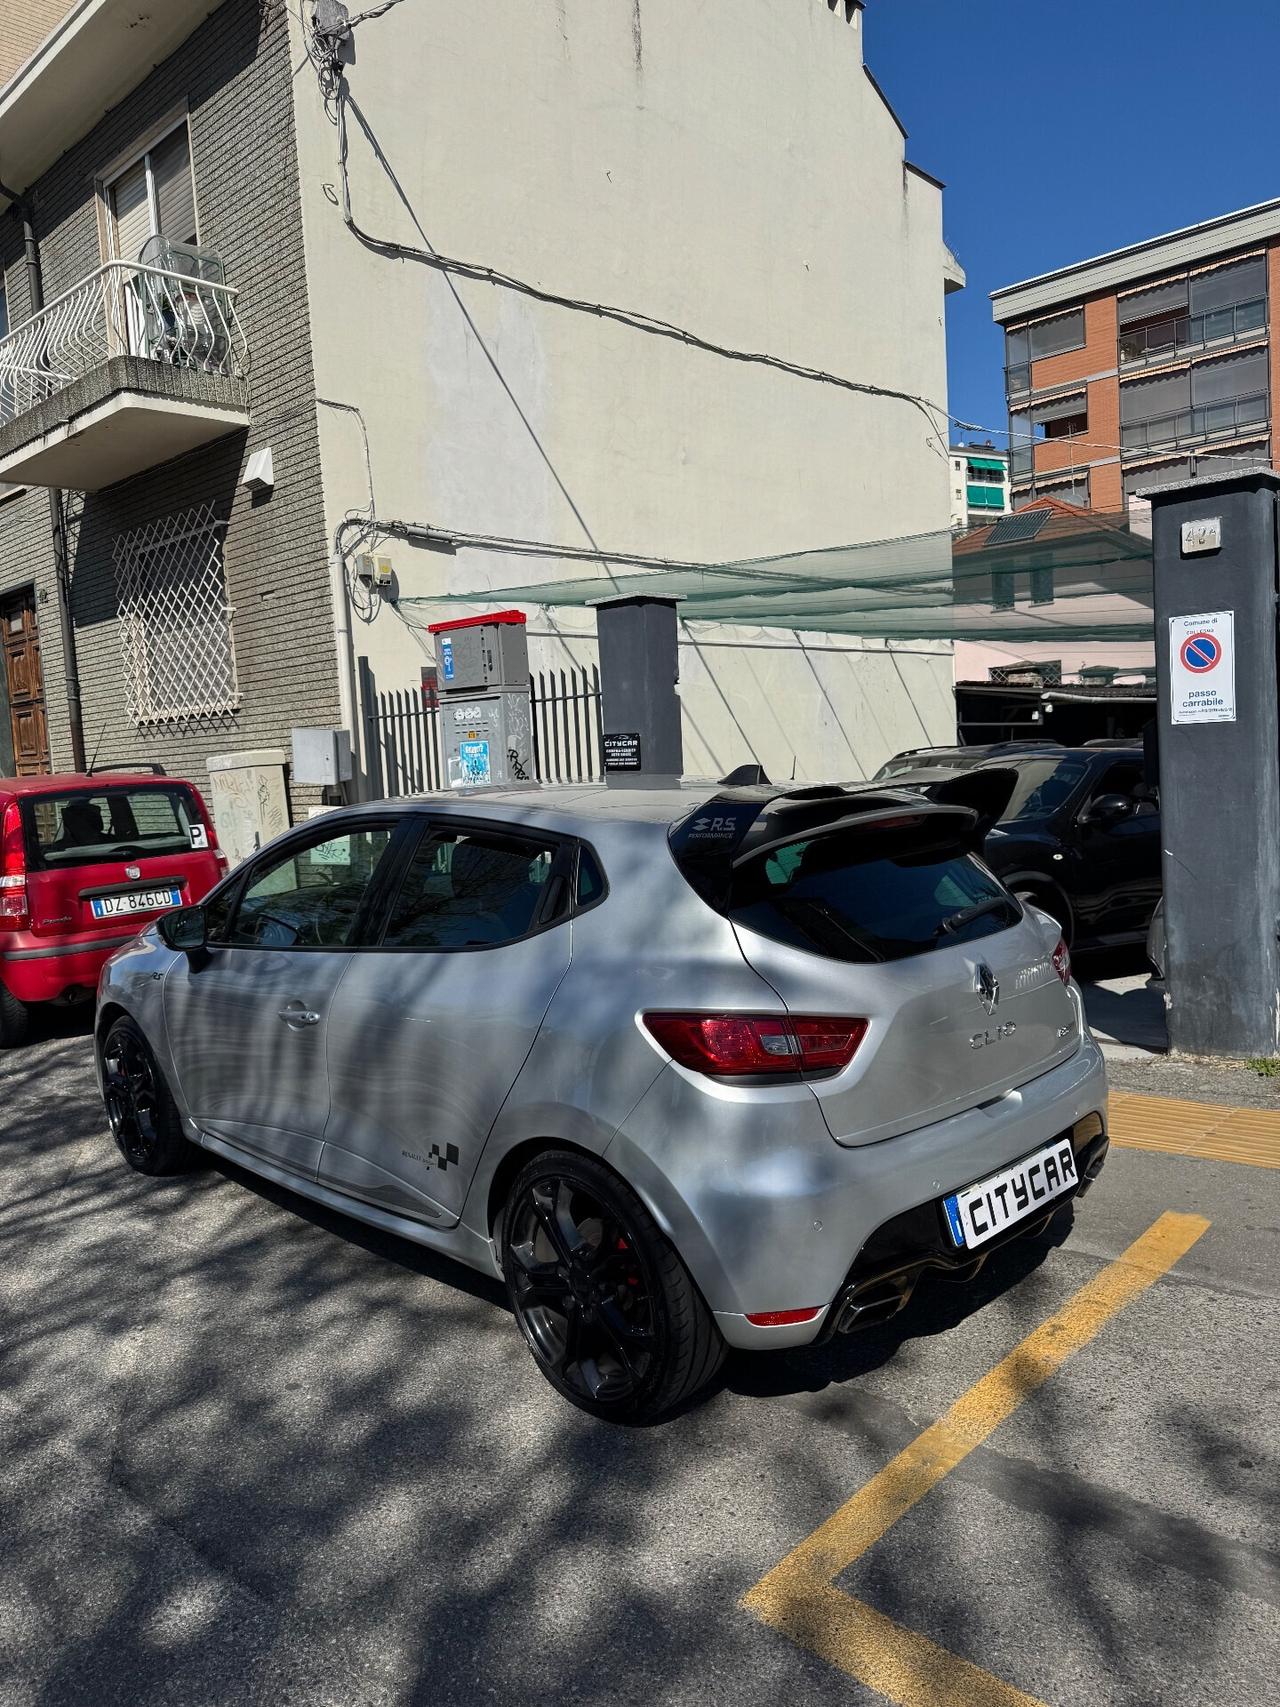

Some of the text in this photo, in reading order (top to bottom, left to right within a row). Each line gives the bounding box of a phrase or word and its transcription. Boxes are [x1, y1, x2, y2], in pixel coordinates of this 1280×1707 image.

[1182, 698, 1224, 708] carrabile
[1188, 690, 1217, 700] passo
[190, 827, 202, 845] P
[103, 897, 124, 913] DZ
[129, 890, 171, 908] 846CD
[969, 1021, 1016, 1050] CLIO
[968, 1147, 1075, 1237] CITYCAR
